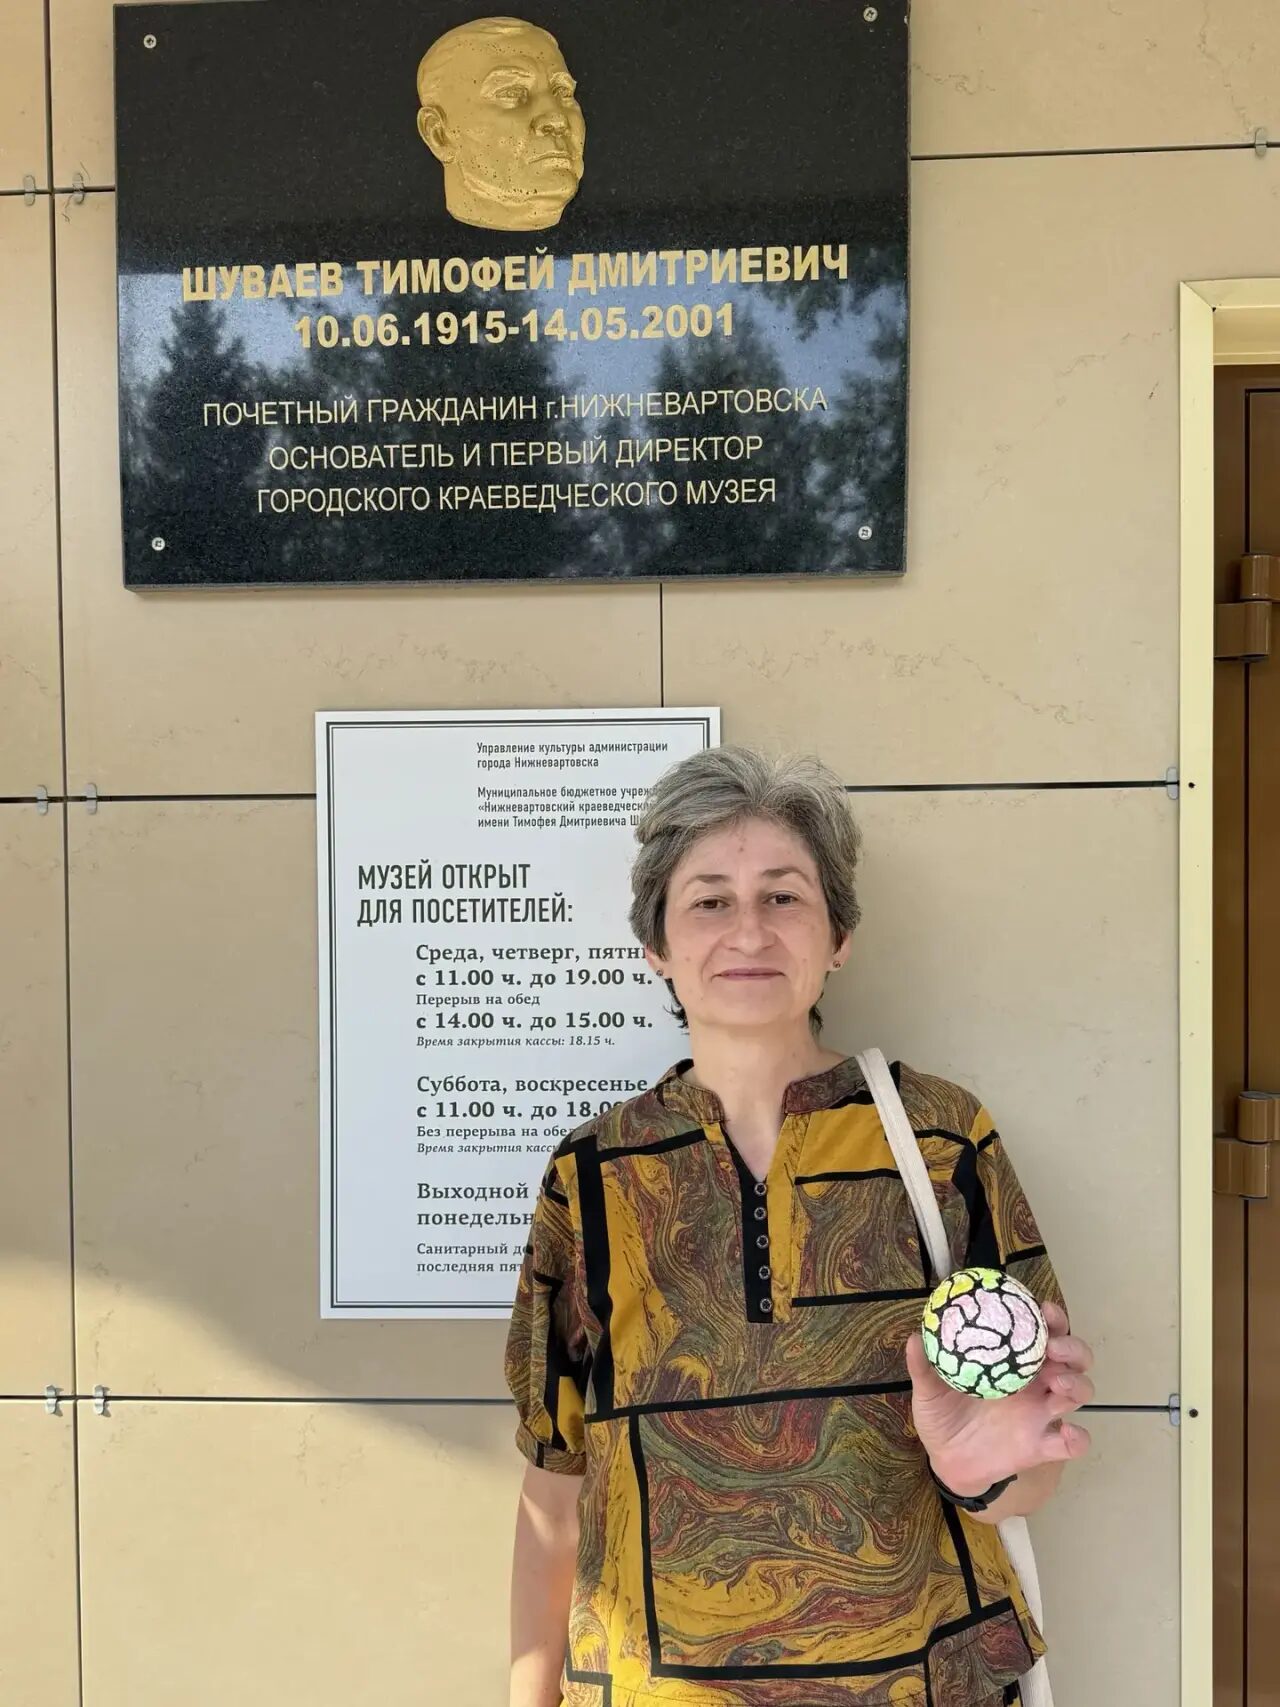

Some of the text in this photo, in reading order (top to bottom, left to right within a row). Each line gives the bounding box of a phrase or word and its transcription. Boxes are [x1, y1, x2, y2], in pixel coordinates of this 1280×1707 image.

[182, 244, 848, 301] ШУВАЕВ ТИМОФЕЙ ДМИТРИЕВИЧ
[295, 303, 733, 349] 10.06.1915-14.05.2001
[204, 387, 828, 426] ПОЧЕТНЫЙ ГРАЖДАНИН г.НИЖНЕВАРТОВСКА
[269, 435, 763, 470] ОСНОВАТЕЛЬ И ПЕРВЫЙ ДИРЕКТОР
[258, 478, 776, 516] ГОРОДСКОГО КРАЕВЕДЧЕСКОГО МУЗЕЯ
[477, 742, 667, 755] Управление культуры администрации
[478, 756, 600, 771] города Нижневартовска
[478, 787, 557, 799] Муниципальное
[561, 786, 616, 798] бюджетное
[478, 800, 575, 813] «Нижневартовский
[478, 819, 509, 827] имени
[513, 815, 556, 829] Тимофея
[560, 815, 627, 829] Дмитриевича
[359, 859, 530, 889] МУЗЕЙ ОТКРЫТ
[357, 892, 572, 927] ДЛЯ ПОСЕТИТЕЛЕЙ:
[416, 945, 483, 964] Среда,
[492, 948, 579, 964] четверг,
[416, 969, 653, 988] с 11.00 ч. до 19.00 ч.
[416, 994, 480, 1007] Перерыв
[508, 993, 540, 1005] обед
[417, 1012, 652, 1031] с 14.00 ч. до 15.00 ч.
[417, 1037, 453, 1048] Время
[457, 1039, 520, 1048] закрытия
[526, 1038, 564, 1046] кассы:
[570, 1036, 600, 1045] 18.15
[417, 1075, 647, 1096] Суббота, воскресенье
[417, 1100, 624, 1120] с 11.00 ч. до 18.0
[417, 1126, 440, 1136] Без
[447, 1129, 515, 1139] перерыва
[543, 1124, 575, 1137] обе
[417, 1143, 557, 1155] Время закрытия касс
[417, 1183, 528, 1201] Выходной
[417, 1243, 507, 1257] Санитарный
[417, 1261, 494, 1273] последняя
